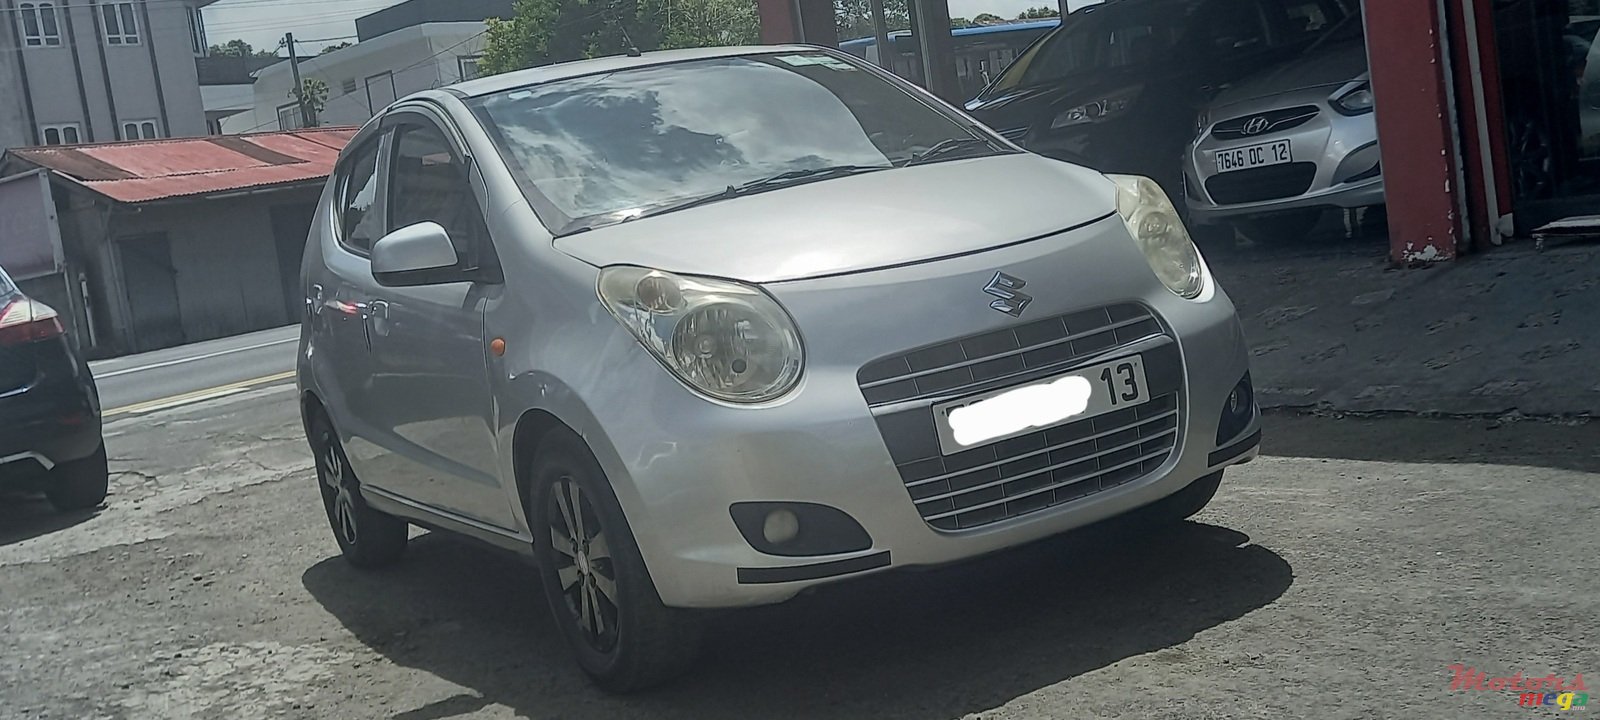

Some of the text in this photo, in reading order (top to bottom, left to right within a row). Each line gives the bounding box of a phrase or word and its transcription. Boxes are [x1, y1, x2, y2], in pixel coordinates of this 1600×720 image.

[1218, 150, 1244, 170] 7646
[1271, 143, 1288, 162] 12
[1100, 362, 1139, 406] 13
